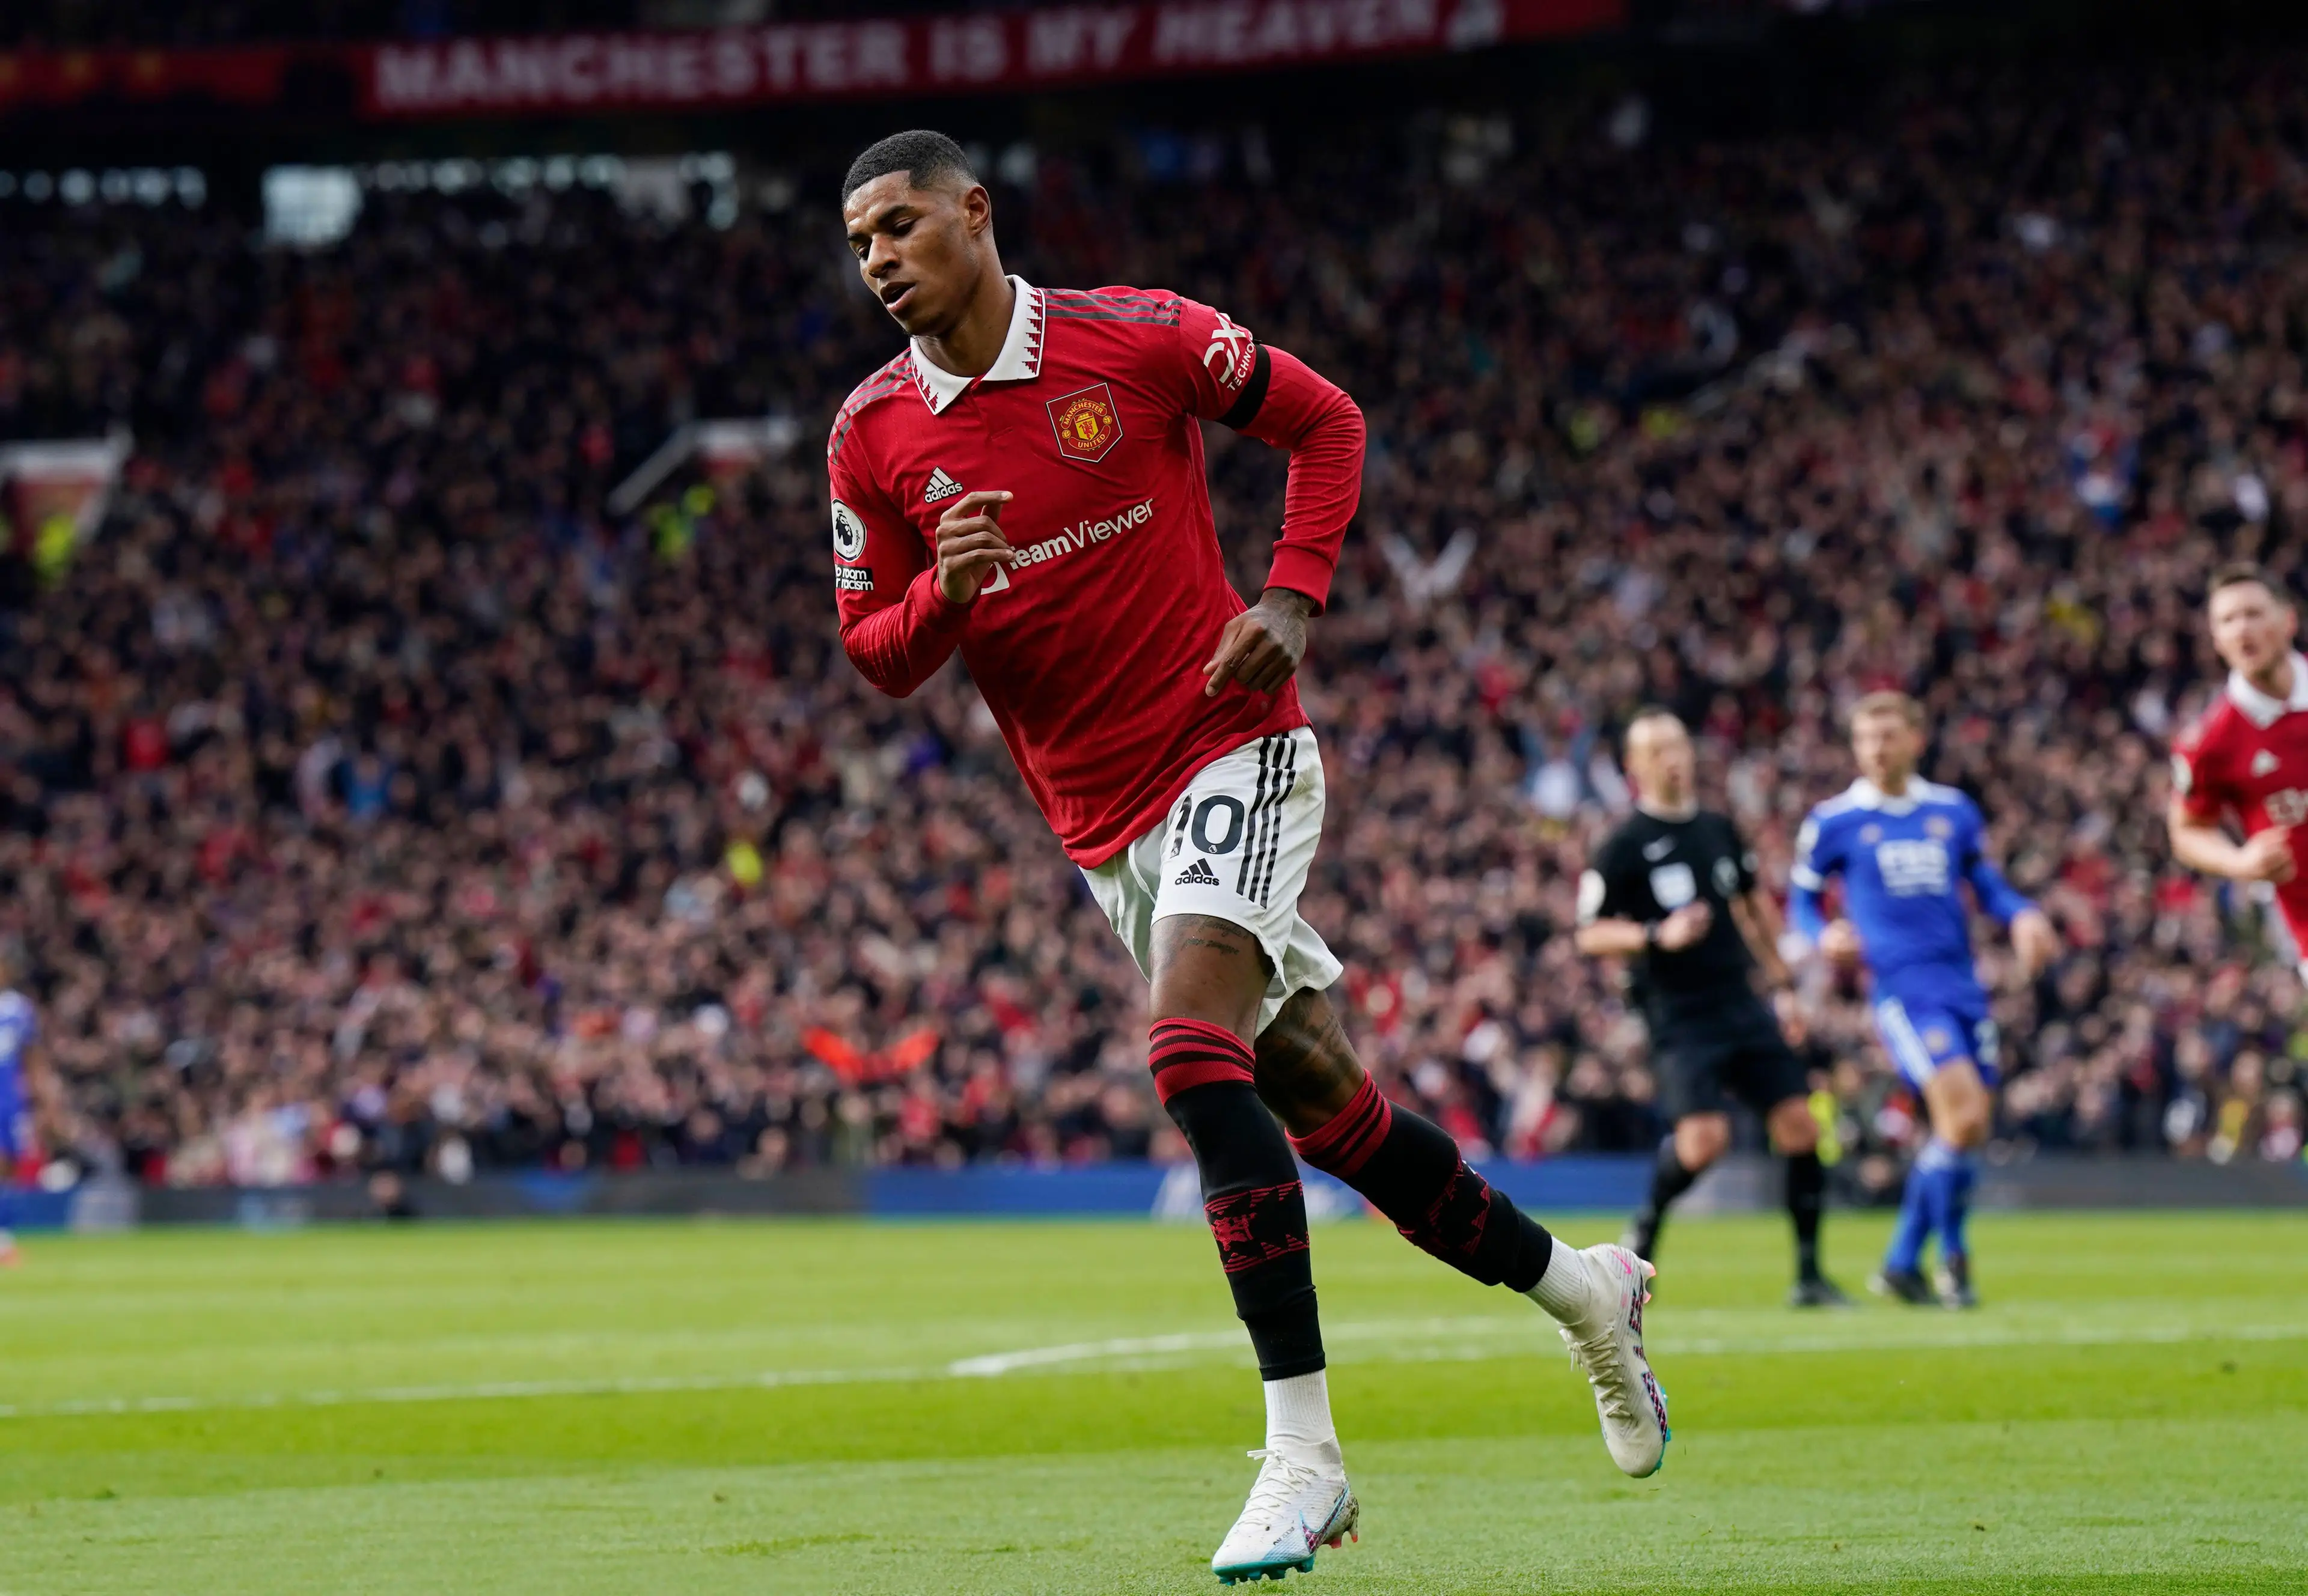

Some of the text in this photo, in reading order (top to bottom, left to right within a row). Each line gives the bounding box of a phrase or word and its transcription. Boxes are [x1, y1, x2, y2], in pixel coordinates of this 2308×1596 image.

[376, 24, 908, 109] MANCHESTER
[927, 17, 1007, 79] IS
[1027, 5, 1139, 73] MY
[1227, 343, 1254, 391] TECHNO
[1063, 402, 1104, 425] MANCHESTER
[1078, 434, 1105, 448] UNITED
[924, 483, 963, 503] adidas
[843, 568, 867, 580] room
[841, 579, 874, 591] racism
[1170, 793, 1245, 859] 10
[1175, 874, 1220, 886] adidas
